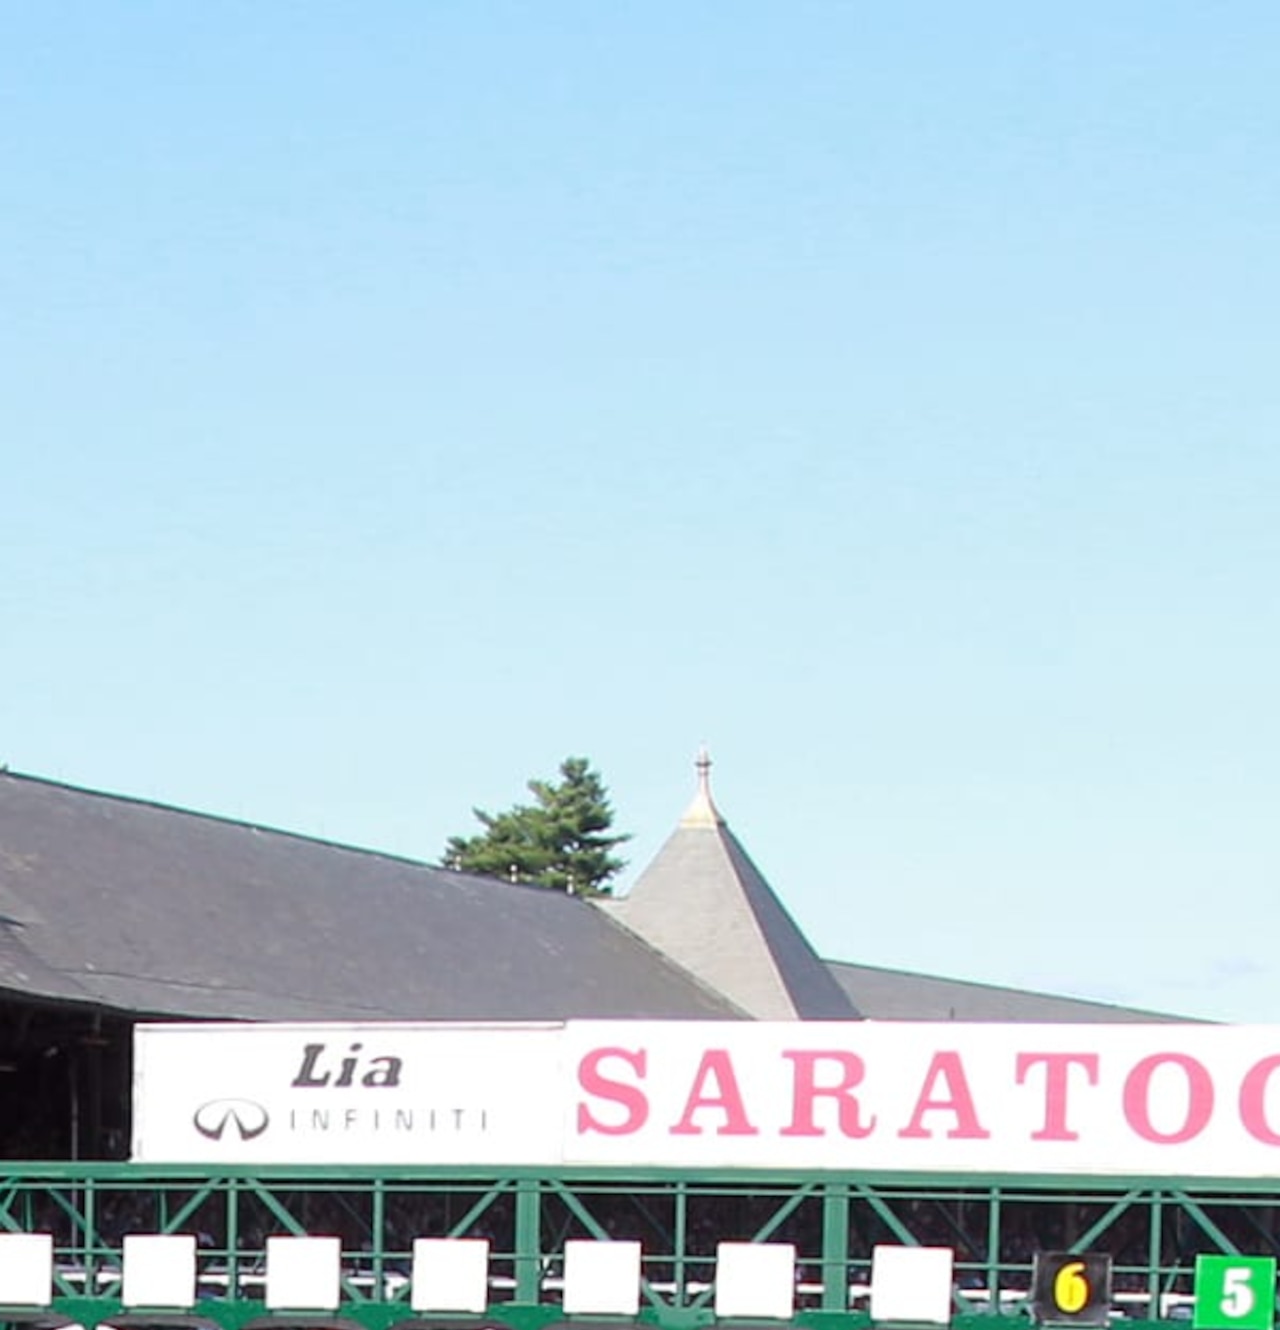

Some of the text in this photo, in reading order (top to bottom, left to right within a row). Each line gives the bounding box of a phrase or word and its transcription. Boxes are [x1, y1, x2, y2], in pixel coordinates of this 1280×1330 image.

[292, 1043, 402, 1088] Lia
[290, 1108, 487, 1132] INFINITI
[1053, 1261, 1090, 1314] 6
[1220, 1267, 1255, 1318] 5
